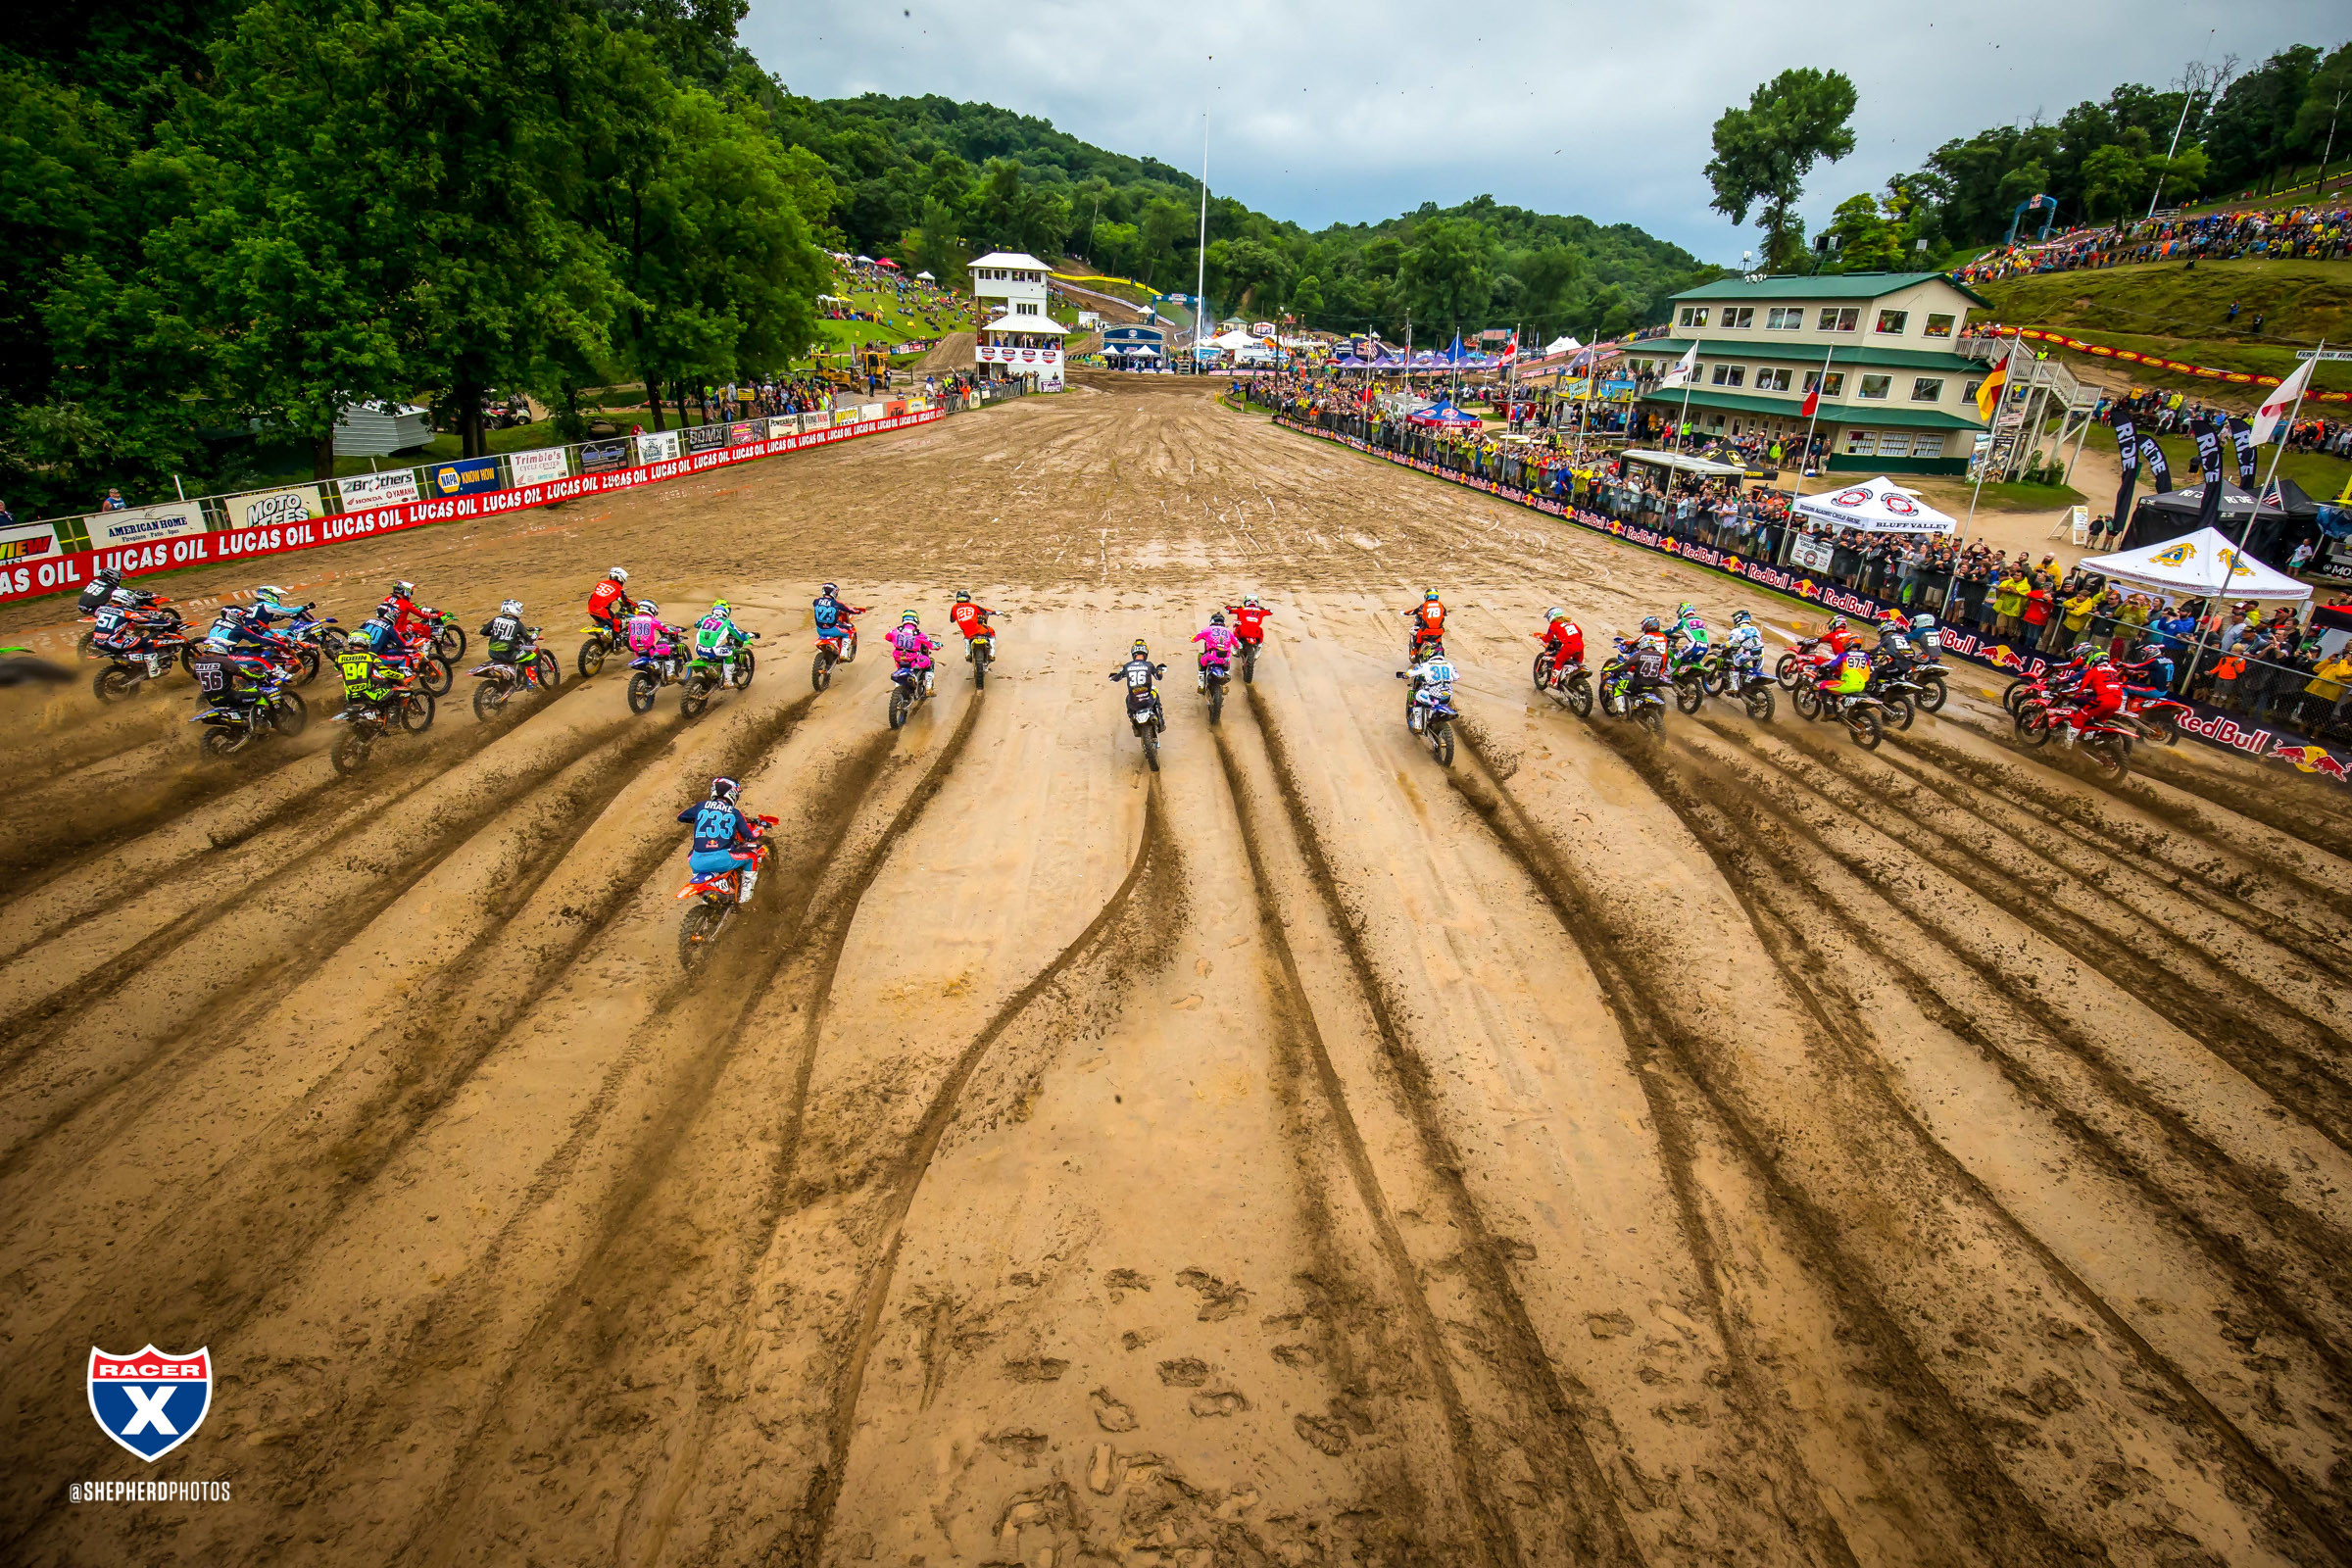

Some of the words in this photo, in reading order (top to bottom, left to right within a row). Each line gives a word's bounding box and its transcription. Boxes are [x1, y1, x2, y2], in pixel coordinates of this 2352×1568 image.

[732, 446, 754, 461] LUCAS
[755, 444, 765, 456] OIL
[767, 439, 787, 454] LUCAS
[787, 437, 797, 449] OIL
[514, 451, 562, 466] Trimble's
[694, 454, 717, 469] LUCAS
[718, 451, 730, 465] OIL
[440, 473, 459, 487] NAPA
[461, 470, 480, 484] KNOW
[480, 467, 495, 481] HOW
[651, 462, 677, 479] LUCAS
[678, 459, 692, 473] OIL
[602, 470, 632, 489] LUCAS
[633, 468, 648, 483] OIL
[393, 487, 416, 498] YAMAHA
[547, 481, 580, 500] LUCAS
[582, 477, 599, 491] OIL
[355, 495, 383, 505] HONDA
[483, 490, 521, 513] LUCAS
[523, 488, 542, 505] OIL
[247, 494, 302, 527] MOTO
[410, 501, 454, 522] LUCAS
[457, 498, 477, 515] OIL
[1815, 507, 1832, 517] AGAINST
[1832, 512, 1846, 520] CHILD
[1846, 515, 1861, 525] ABUSE
[108, 519, 160, 537] AMERICAN
[161, 516, 188, 529] HOME
[322, 513, 374, 540] LUCAS
[378, 510, 403, 528] OIL
[219, 528, 280, 556] LUCAS
[285, 524, 315, 546] OIL
[93, 544, 168, 577] LUCAS
[173, 538, 208, 563] OIL
[38, 560, 80, 588] OIL
[814, 605, 837, 623] 123
[957, 608, 974, 620] 26
[1426, 608, 1441, 618] 78
[896, 634, 914, 649] 66
[1211, 628, 1228, 638] 34
[1927, 636, 1940, 647] 91
[1894, 638, 1910, 650] 52
[343, 662, 368, 680] 194
[1640, 661, 1660, 677] 45
[1847, 658, 1866, 669] 979
[1128, 671, 1147, 686] 36
[705, 801, 733, 813] DRAKE
[695, 808, 736, 840] 233
